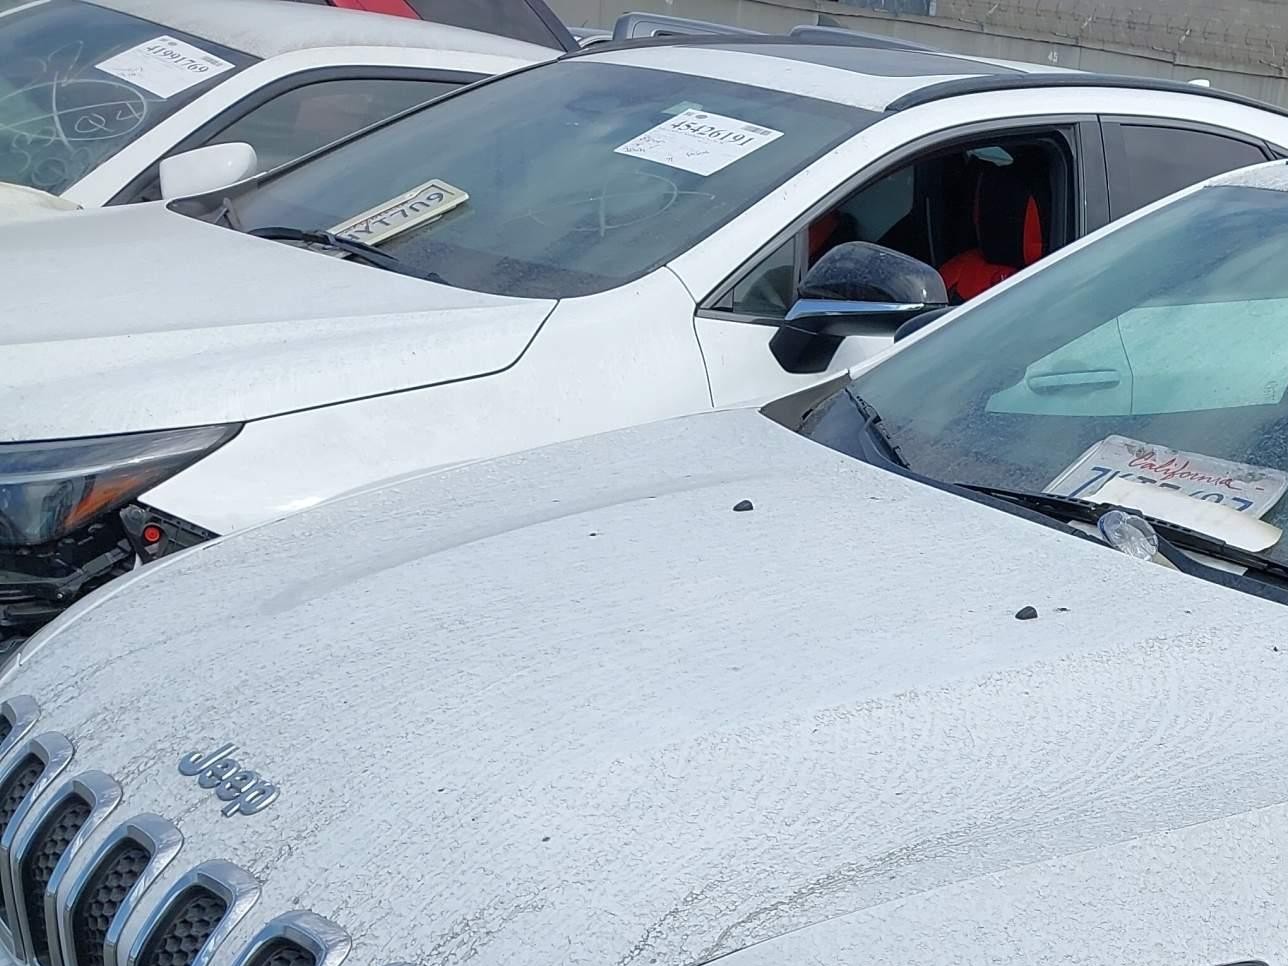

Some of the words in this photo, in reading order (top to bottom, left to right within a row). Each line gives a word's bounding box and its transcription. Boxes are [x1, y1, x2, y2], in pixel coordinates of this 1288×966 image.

[145, 45, 209, 73] 41991769
[671, 120, 755, 146] 45426191
[1128, 452, 1243, 491] California
[178, 742, 280, 819] Jeep
